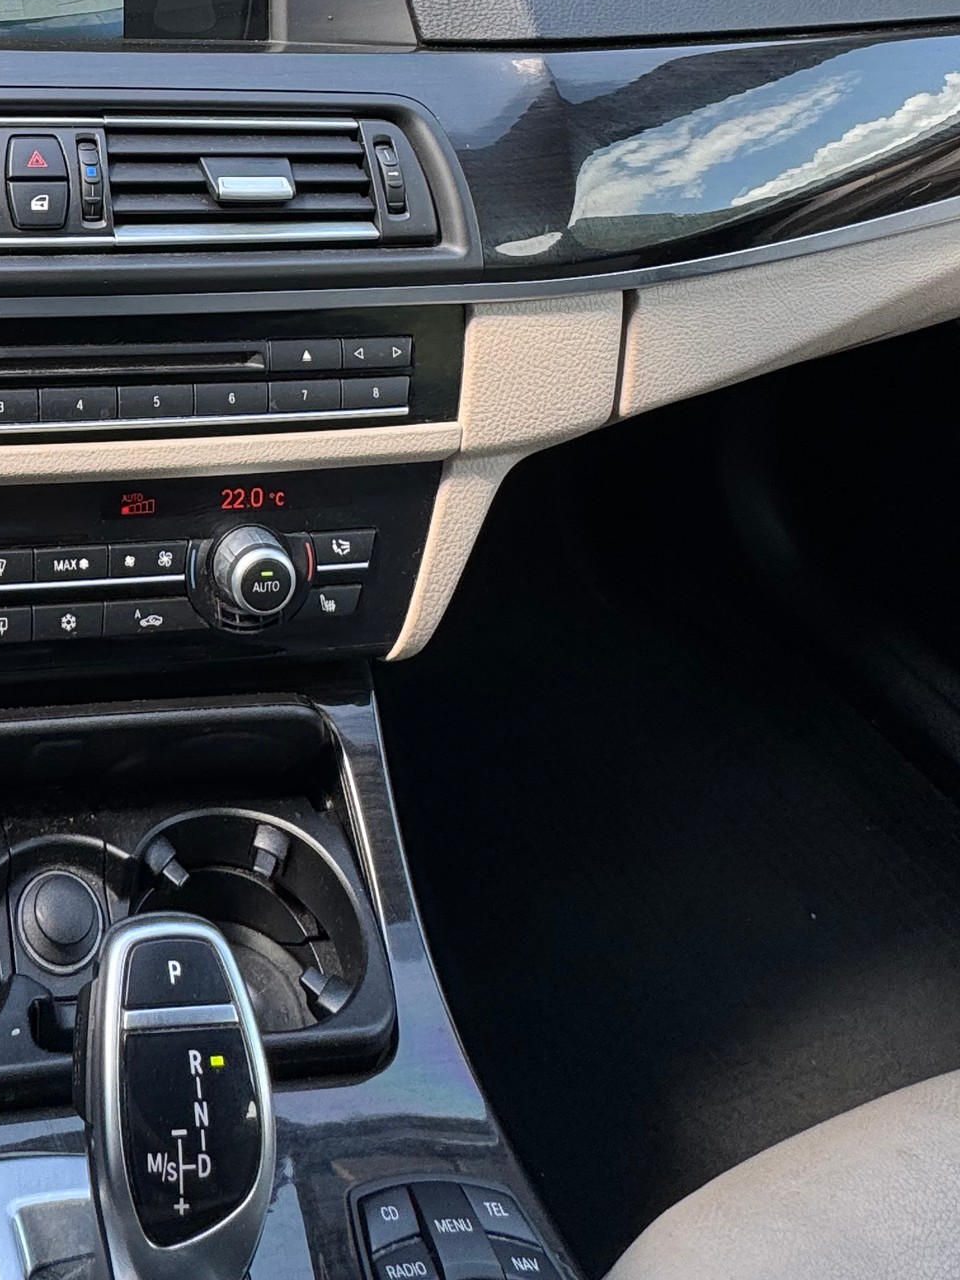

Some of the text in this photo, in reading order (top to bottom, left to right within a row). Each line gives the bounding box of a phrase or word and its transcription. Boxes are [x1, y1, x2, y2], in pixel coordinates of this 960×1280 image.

[228, 392, 236, 405] 6
[302, 389, 308, 402] 7
[372, 387, 380, 399] 8
[76, 398, 84, 412] 4
[152, 395, 161, 408] 5
[121, 494, 144, 504] AUTO
[221, 488, 285, 510] 22.0 °C
[54, 559, 78, 572] MAX
[252, 580, 281, 594] AUTO
[135, 609, 141, 620] A
[167, 960, 182, 985] P
[188, 1050, 203, 1076] R
[193, 1101, 209, 1127] N
[197, 1153, 212, 1178] D
[380, 1206, 399, 1220] CD
[483, 1202, 509, 1217] TEL
[434, 1218, 473, 1233] MENU
[385, 1261, 427, 1279] RADIO
[511, 1256, 539, 1272] NAV
